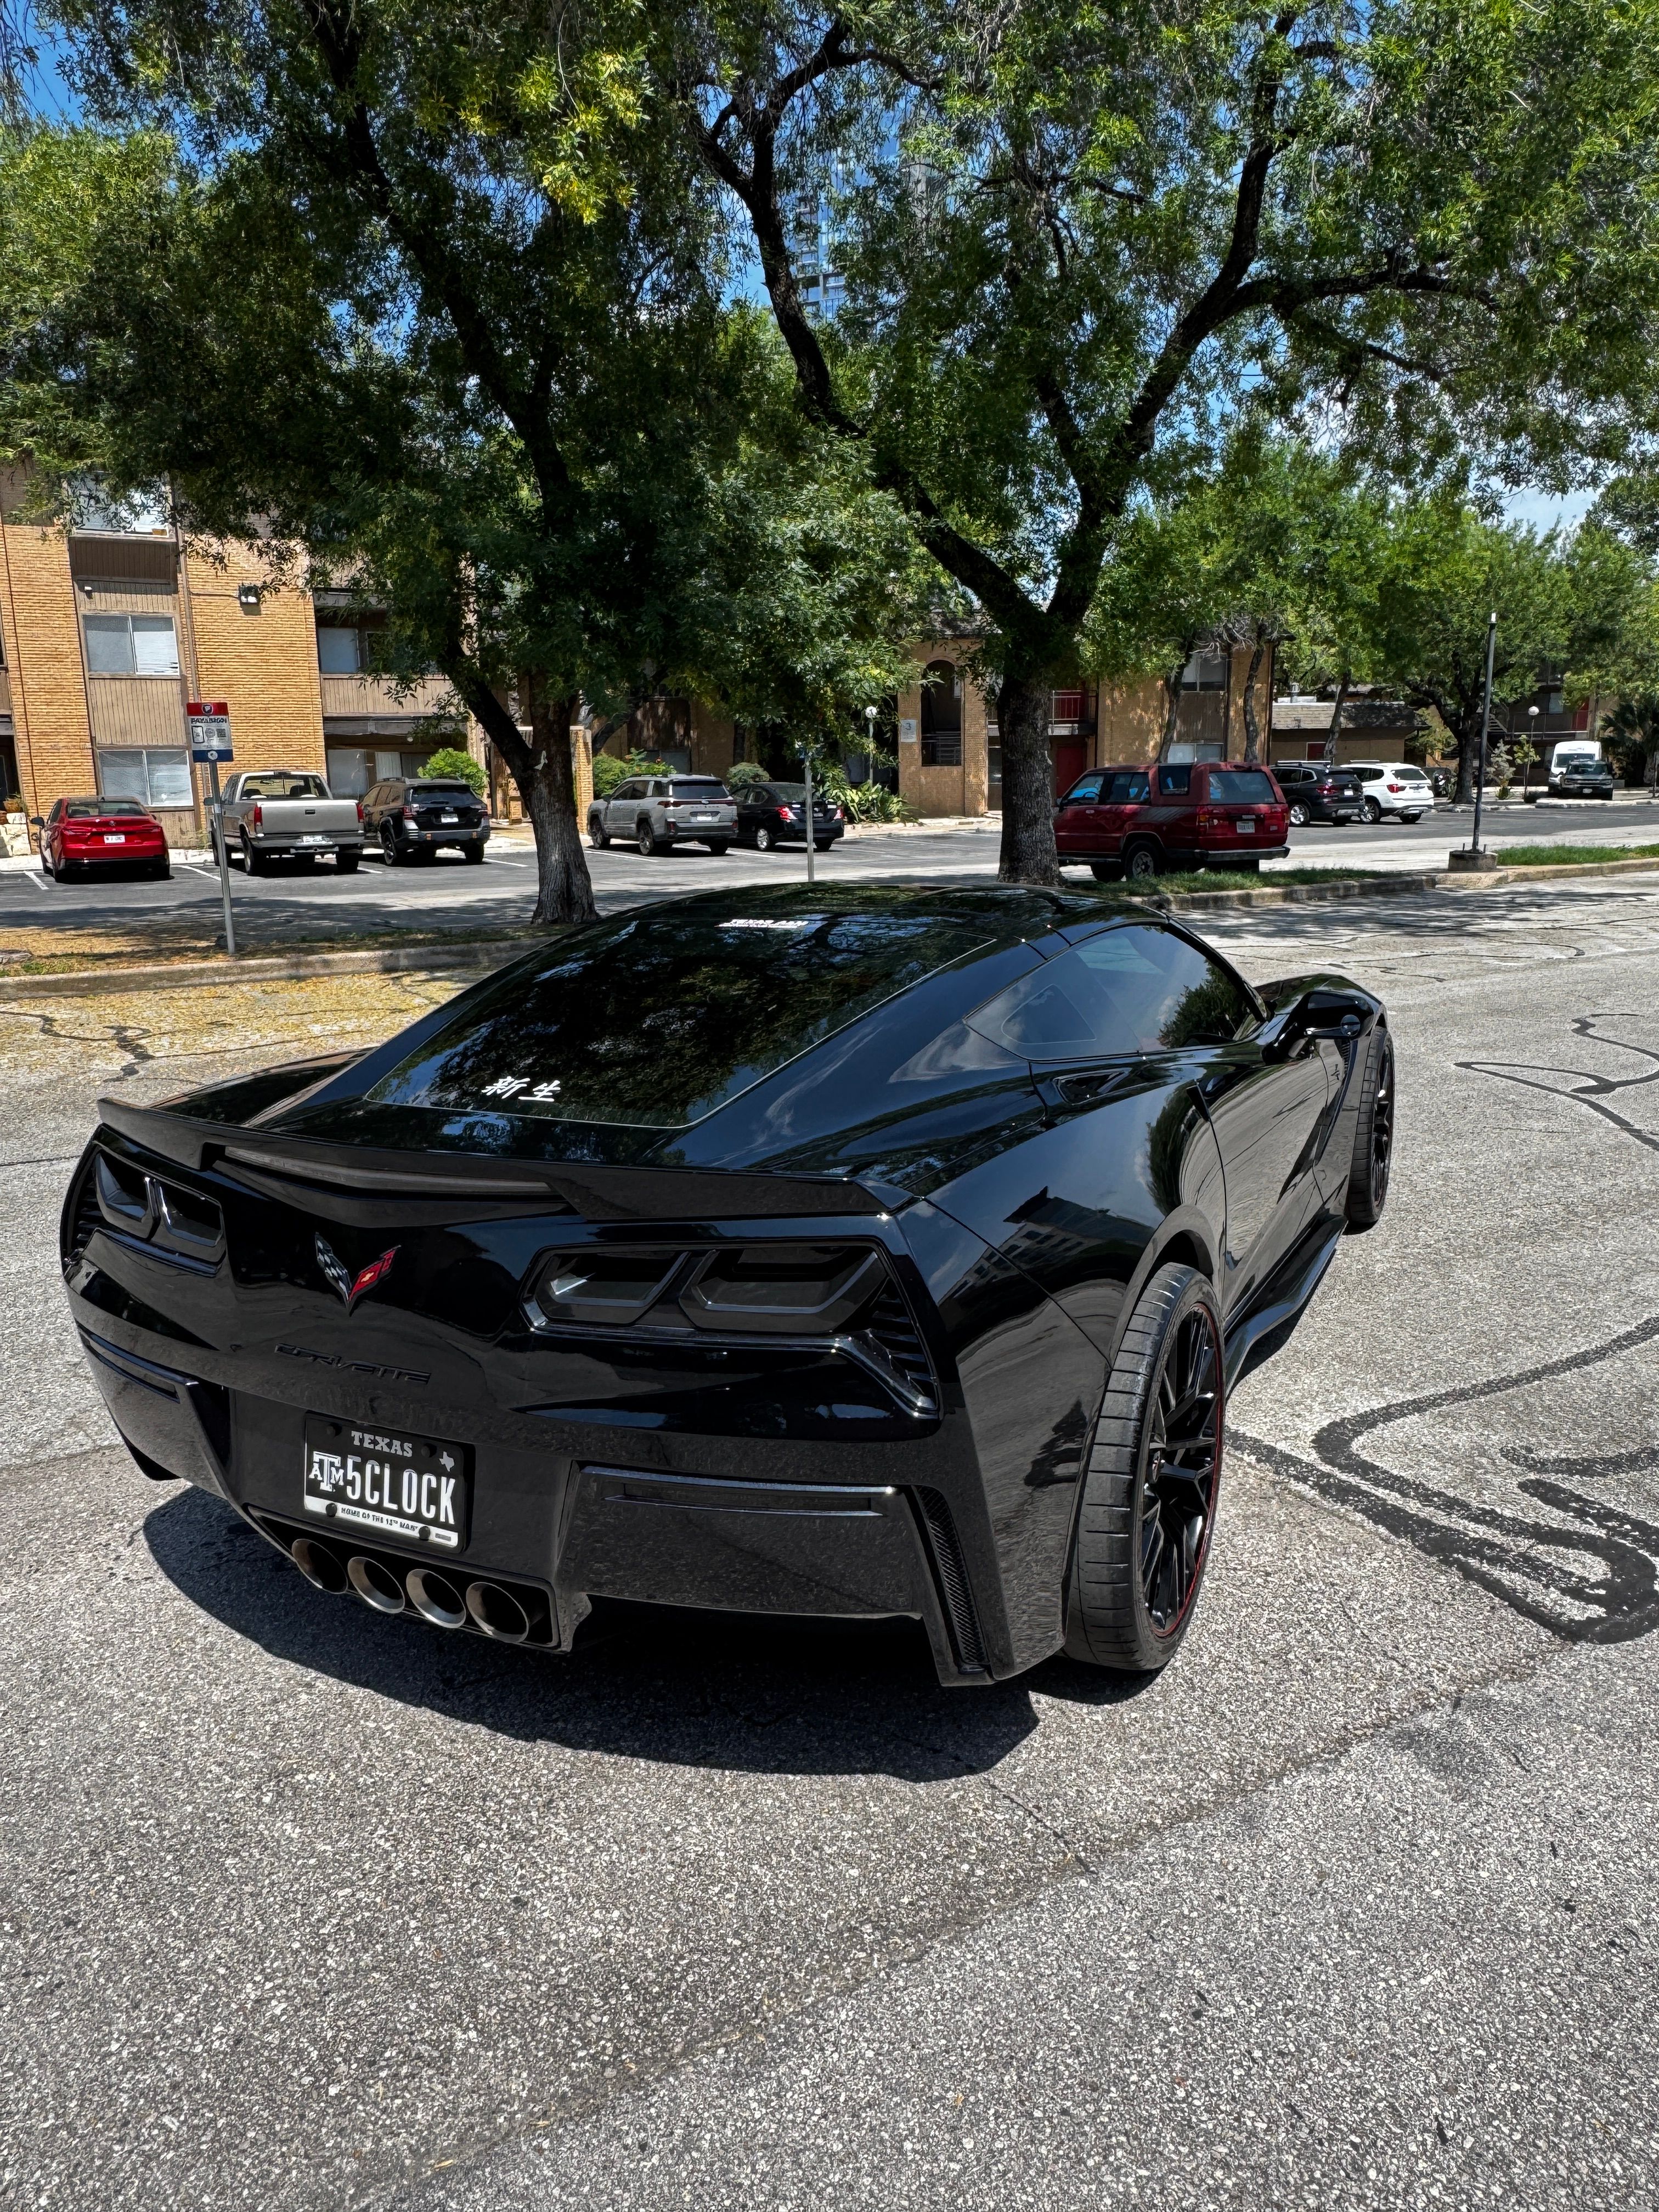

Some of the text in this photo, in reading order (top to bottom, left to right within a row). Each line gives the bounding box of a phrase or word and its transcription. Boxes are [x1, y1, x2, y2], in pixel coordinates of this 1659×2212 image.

[481, 1076, 561, 1102] 新生
[351, 1430, 413, 1458] TEXAS
[346, 1454, 456, 1525] 5CLOCK
[341, 1507, 360, 1517] HOME
[372, 1514, 383, 1523] THE
